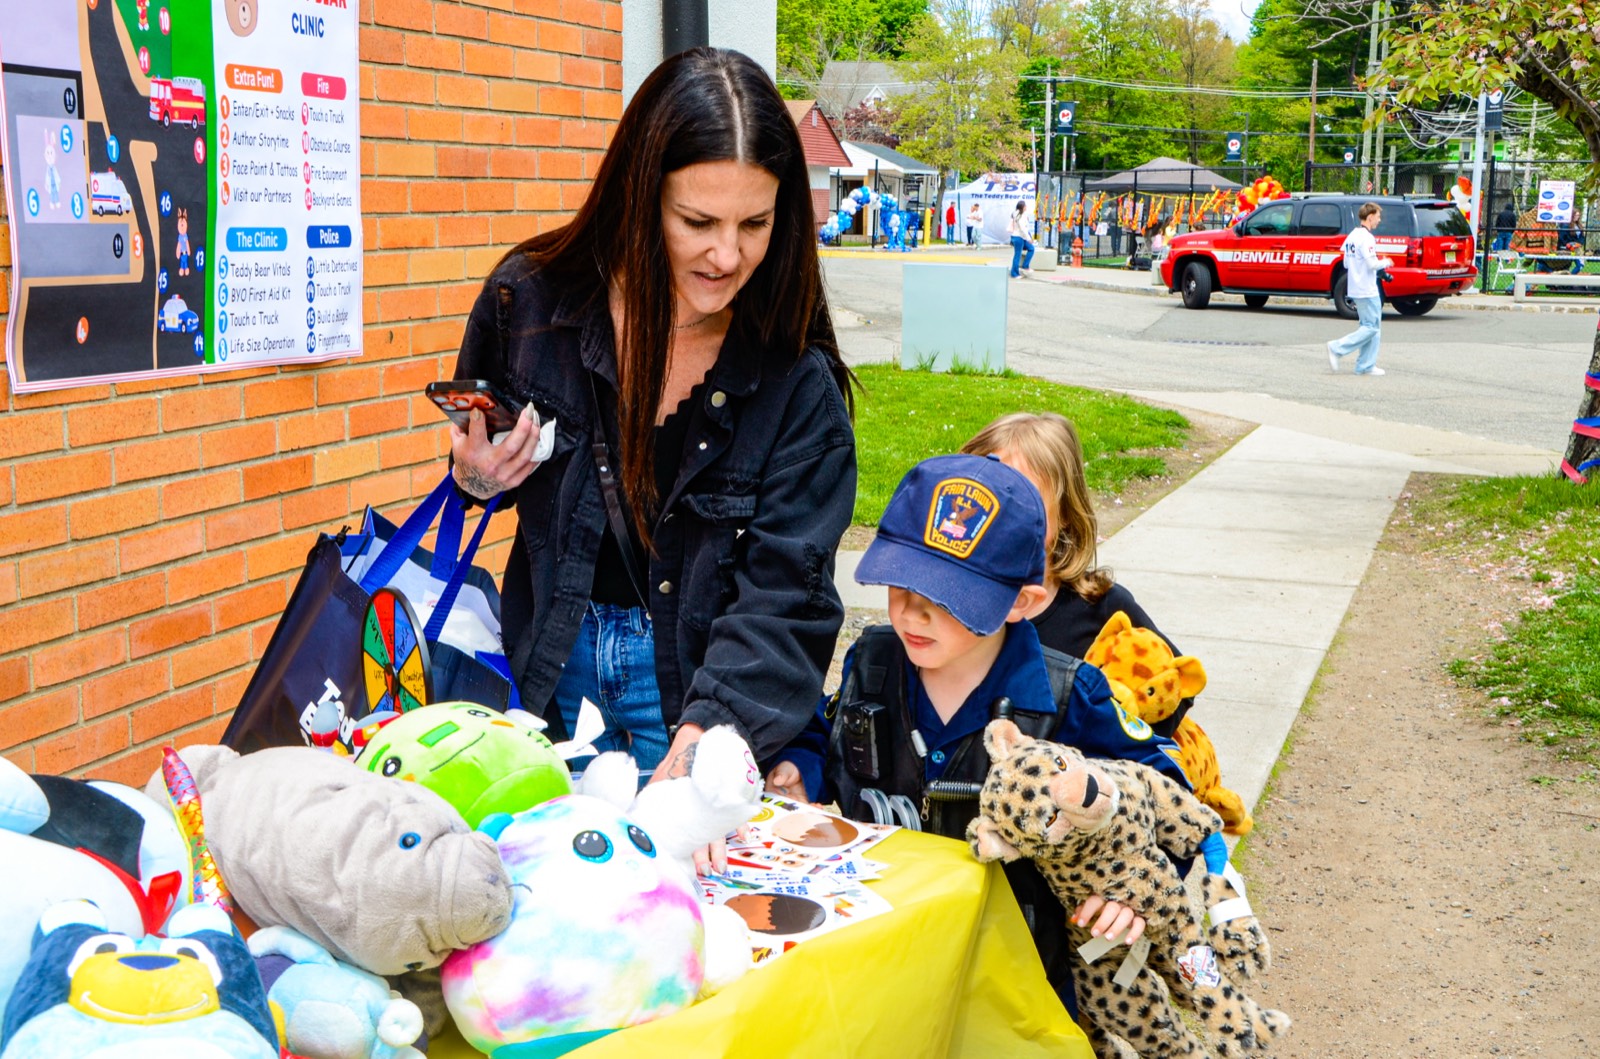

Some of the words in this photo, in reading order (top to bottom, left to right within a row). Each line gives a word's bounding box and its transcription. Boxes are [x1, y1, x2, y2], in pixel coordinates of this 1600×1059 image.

[160, 11, 170, 31] 10
[292, 12, 324, 38] CLINIC
[234, 68, 255, 86] Extra
[257, 71, 274, 88] Fun!
[317, 78, 329, 94] Fire
[233, 100, 269, 118] Enter/Exit
[276, 106, 294, 121] Snacks
[302, 104, 308, 123] 9
[310, 107, 324, 122] Touch
[325, 112, 328, 122] a
[329, 109, 344, 124] Truck
[62, 128, 71, 149] 5
[222, 127, 228, 145] 2
[233, 132, 256, 146] Author
[259, 134, 289, 150] Storytime
[310, 137, 332, 152] Obstacle
[333, 139, 351, 154] Course
[110, 140, 117, 158] 7
[196, 142, 204, 160] 9
[222, 156, 228, 174] 3
[232, 160, 248, 176] Face
[250, 162, 267, 176] Paint
[270, 162, 274, 176] &
[276, 163, 298, 178] Tattoos
[311, 165, 321, 180] Fire
[322, 166, 347, 184] Equipment
[30, 192, 37, 213] 6
[74, 194, 81, 216] 8
[161, 195, 171, 212] 16
[233, 188, 248, 202] Visit
[250, 192, 262, 202] our
[264, 188, 292, 204] Partners
[312, 192, 335, 210] Backyard
[336, 192, 352, 206] Games
[236, 232, 252, 248] The
[254, 232, 278, 248] Clinic
[320, 229, 339, 244] Police
[134, 237, 142, 256] 3
[196, 250, 204, 266] 13
[316, 260, 330, 274] Little
[331, 260, 358, 273] Detectives
[1232, 251, 1291, 264] DENVILLE
[1292, 252, 1321, 265] FIRE
[220, 260, 227, 276] 5
[230, 263, 252, 281] Teddy
[254, 262, 270, 278] Bear
[272, 262, 290, 277] Vitals
[159, 272, 168, 288] 15
[220, 286, 227, 303] 6
[231, 288, 247, 302] BYO
[250, 288, 266, 302] First
[268, 287, 280, 300] Aid
[282, 288, 291, 300] Kit
[316, 283, 332, 297] Touch
[333, 286, 337, 296] a
[338, 282, 351, 296] Truck
[220, 314, 226, 330] 7
[230, 312, 250, 327] Touch
[252, 316, 256, 326] a
[258, 311, 278, 325] Truck
[317, 309, 331, 324] Build
[336, 308, 348, 325] Badge
[194, 335, 204, 352] 14
[220, 342, 227, 358] 8
[230, 340, 244, 354] Life
[246, 338, 261, 352] Size
[263, 336, 295, 354] Operation
[318, 332, 351, 350] Fingerprinting
[942, 484, 966, 496] FAIR
[966, 486, 993, 512] LAWN
[932, 528, 971, 552] POLICE
